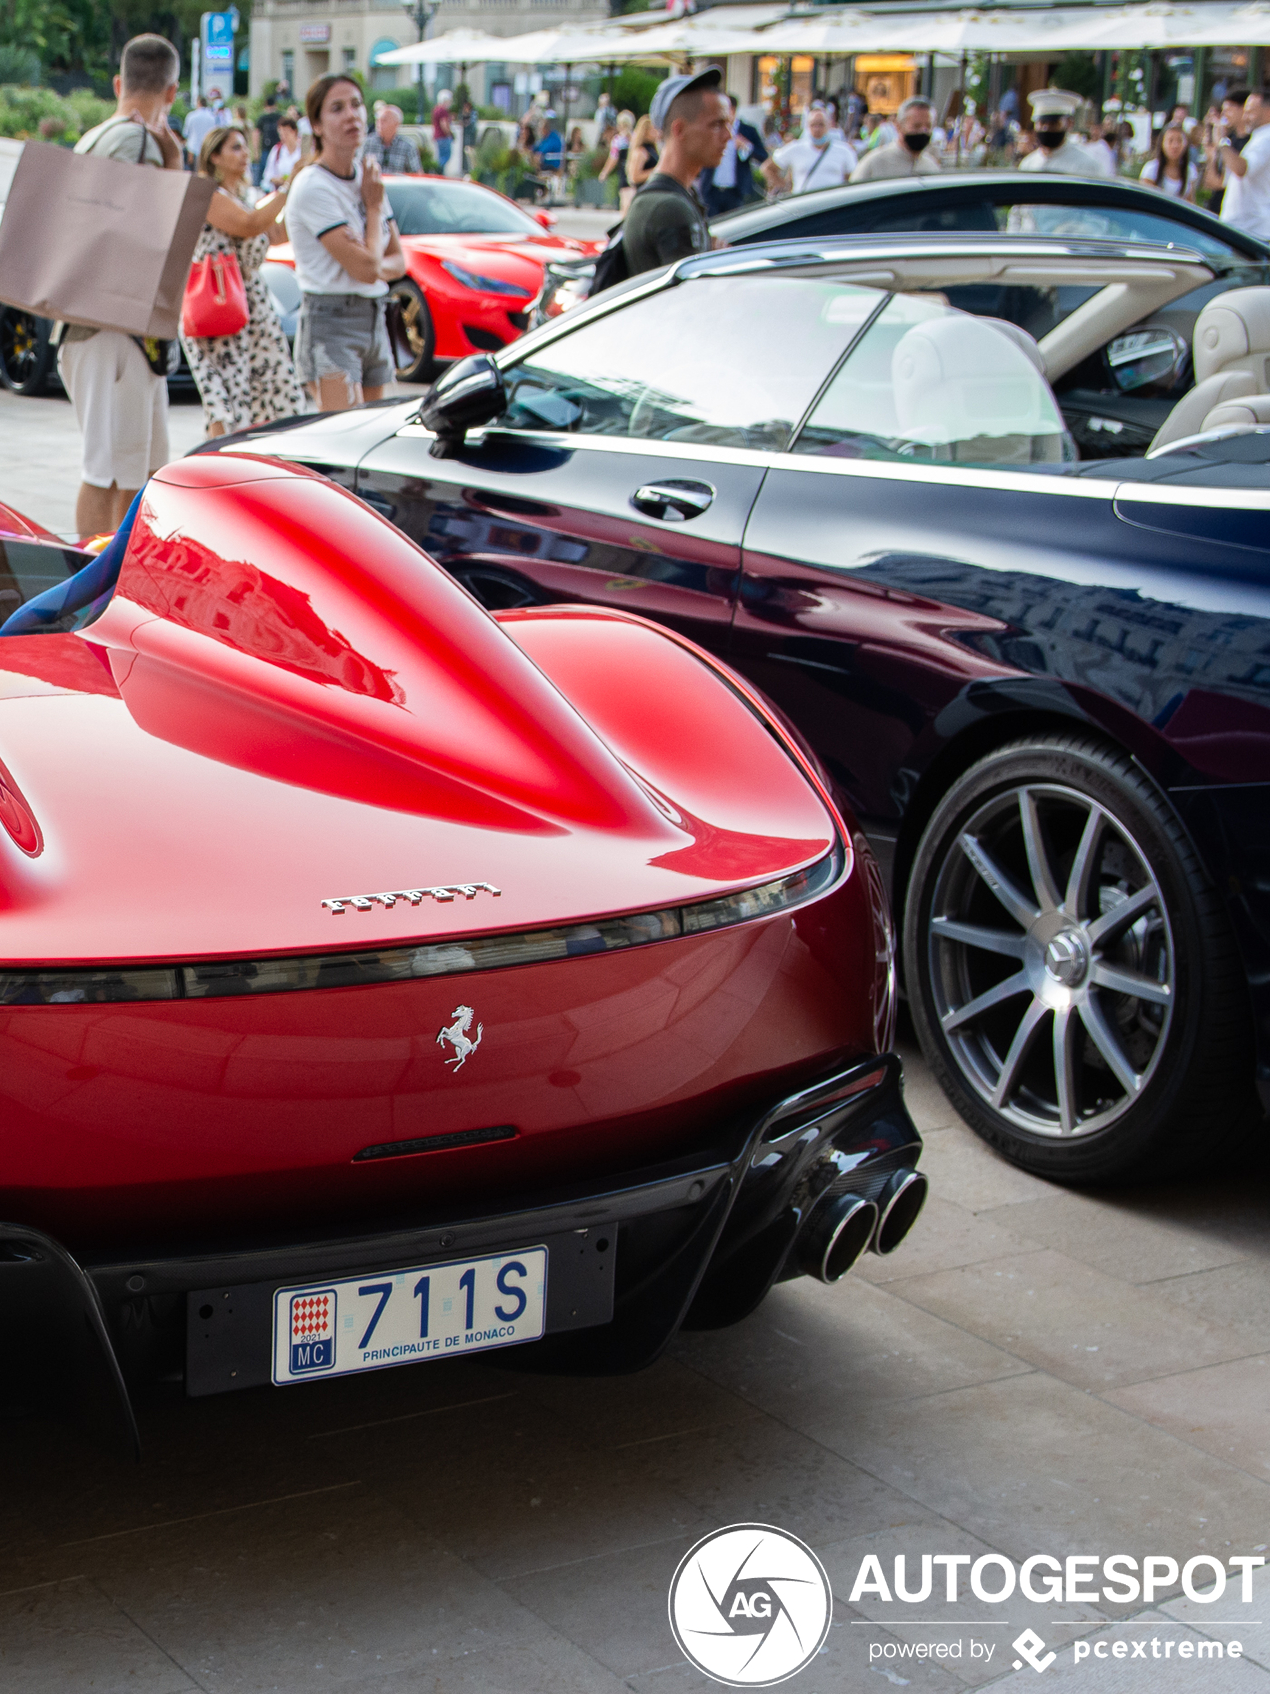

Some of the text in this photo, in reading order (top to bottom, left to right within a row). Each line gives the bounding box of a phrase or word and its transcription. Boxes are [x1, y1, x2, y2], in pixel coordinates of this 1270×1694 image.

[320, 881, 502, 915] Ferrari
[358, 1261, 527, 1349] 711S
[297, 1343, 324, 1366] MC
[300, 1333, 321, 1343] 2021
[363, 1325, 515, 1362] PRINCIPAUTE DE MONACO
